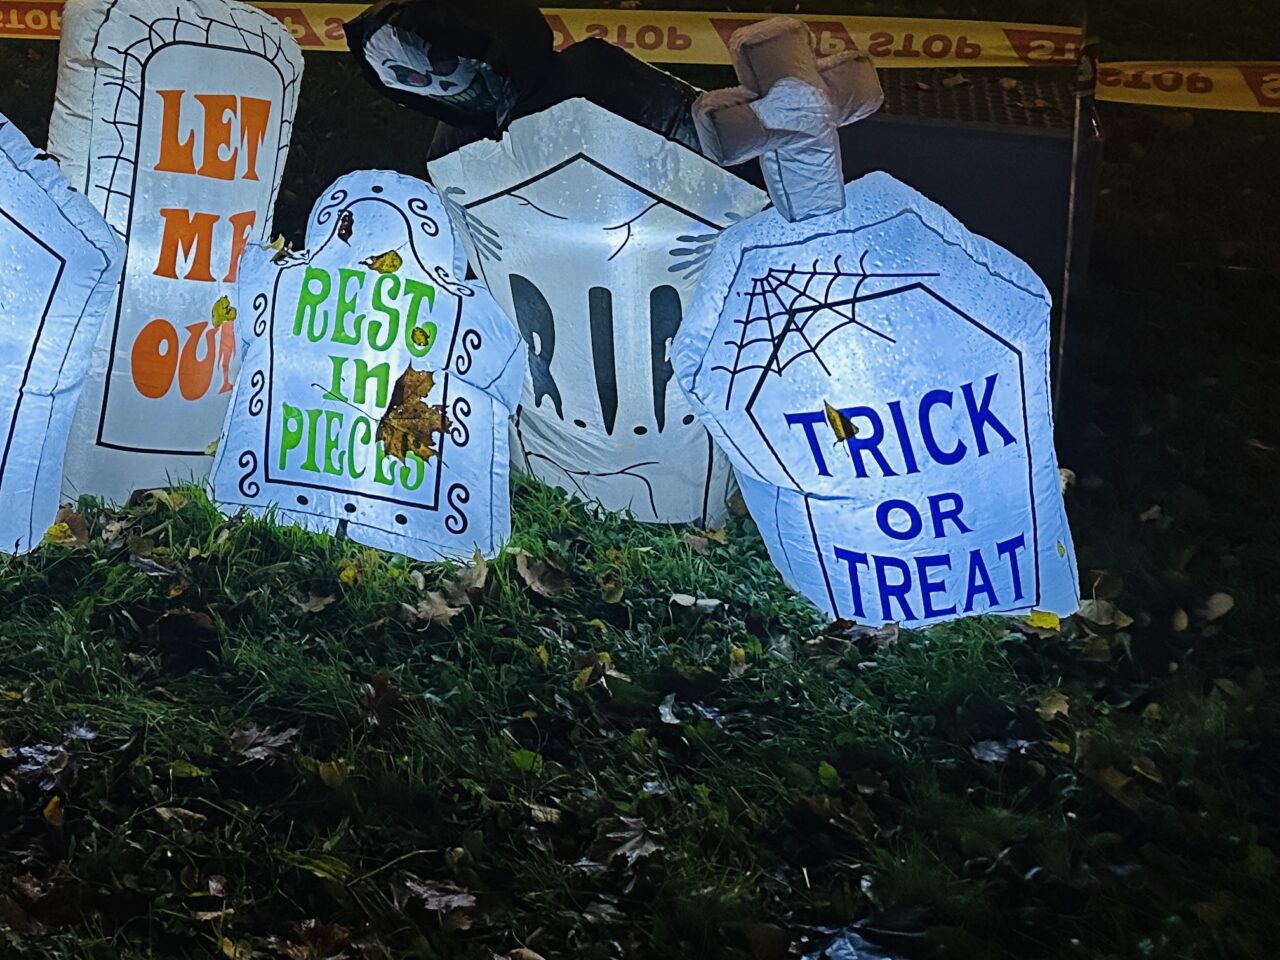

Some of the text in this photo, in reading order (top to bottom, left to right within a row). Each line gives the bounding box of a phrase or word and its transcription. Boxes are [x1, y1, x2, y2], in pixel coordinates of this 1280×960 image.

[154, 90, 272, 181] LET
[293, 266, 438, 357] REST
[783, 373, 1017, 478] TRICK
[876, 492, 973, 540] OR
[834, 533, 1026, 621] TREAT
